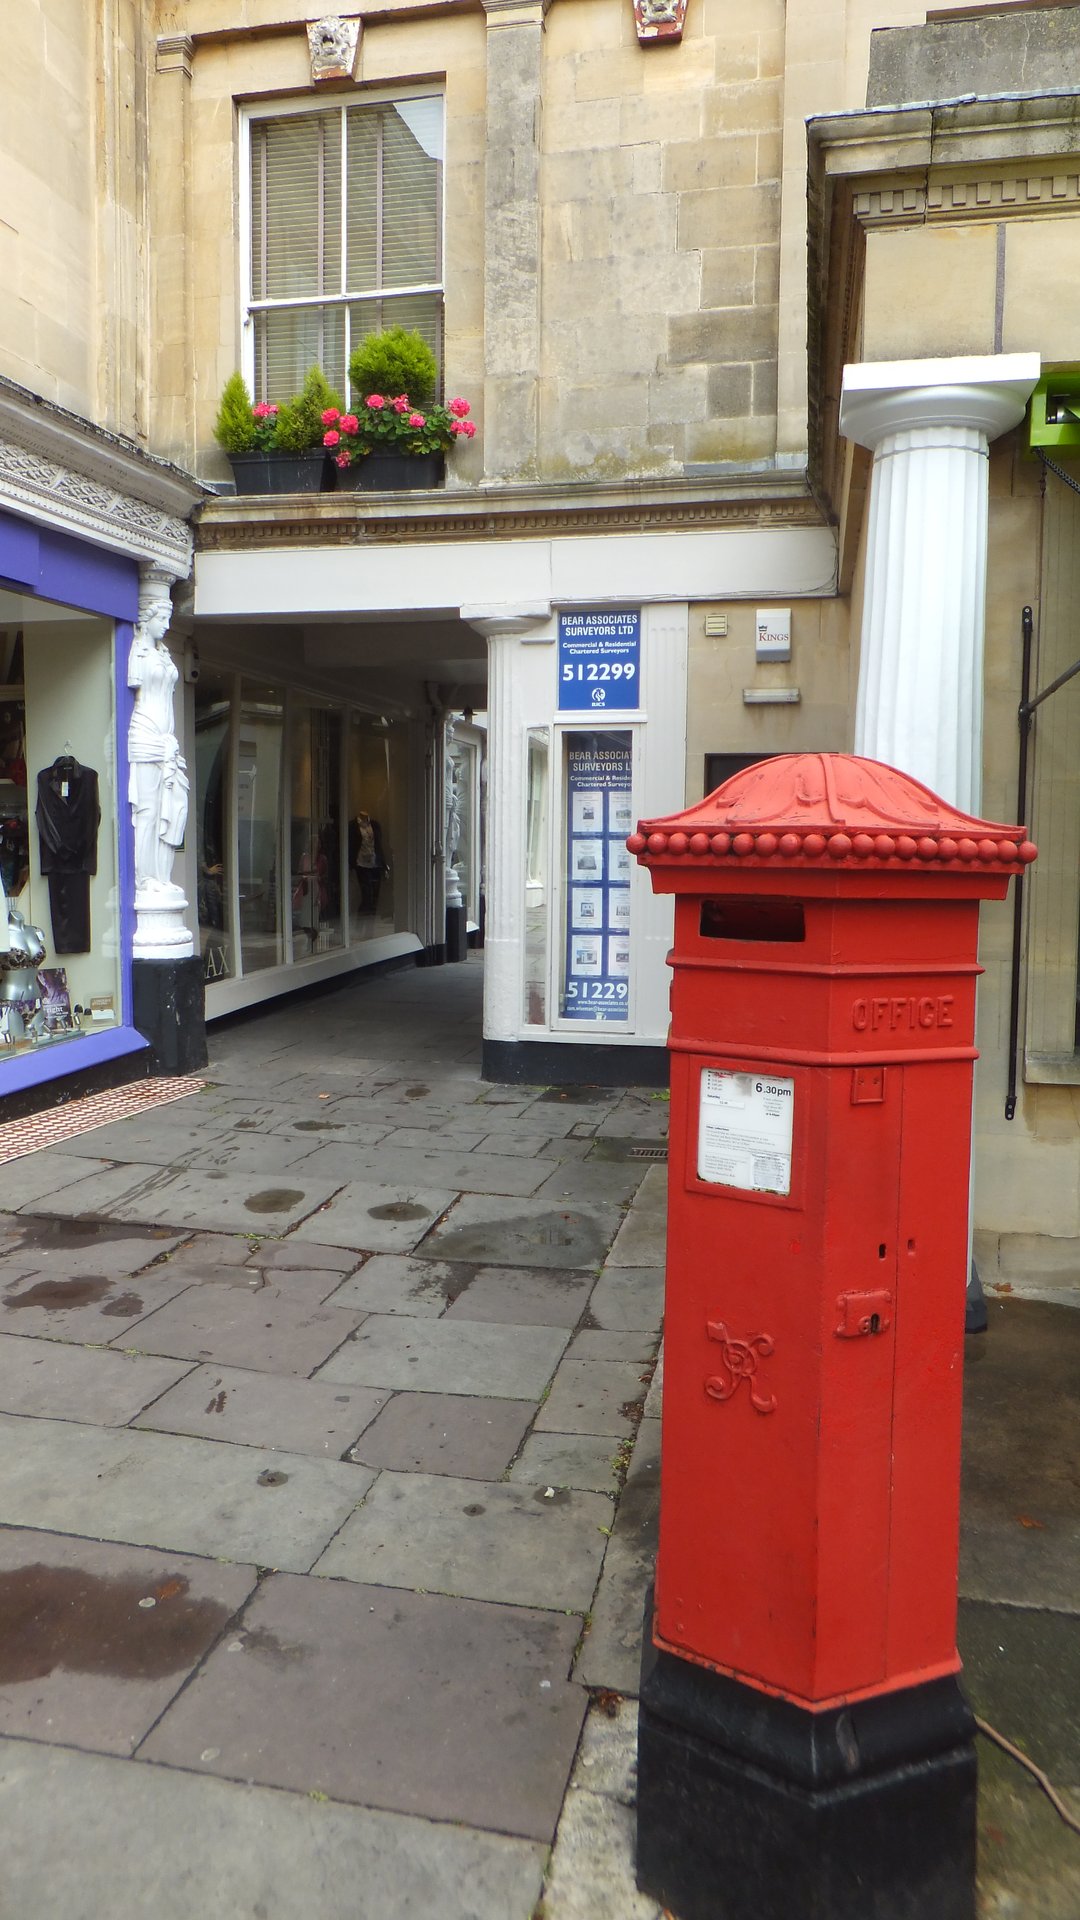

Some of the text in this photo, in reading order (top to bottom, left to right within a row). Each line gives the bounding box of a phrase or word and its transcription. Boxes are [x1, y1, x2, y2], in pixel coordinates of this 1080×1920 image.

[562, 615, 637, 625] BEAR ASSOCIATES
[565, 626, 633, 636] SURVEYORS LTD
[562, 663, 635, 680] 512299
[569, 751, 591, 760] BEAR
[573, 762, 623, 771] SURVEYORS
[567, 981, 628, 999] 51229
[852, 995, 954, 1032] OFFICE
